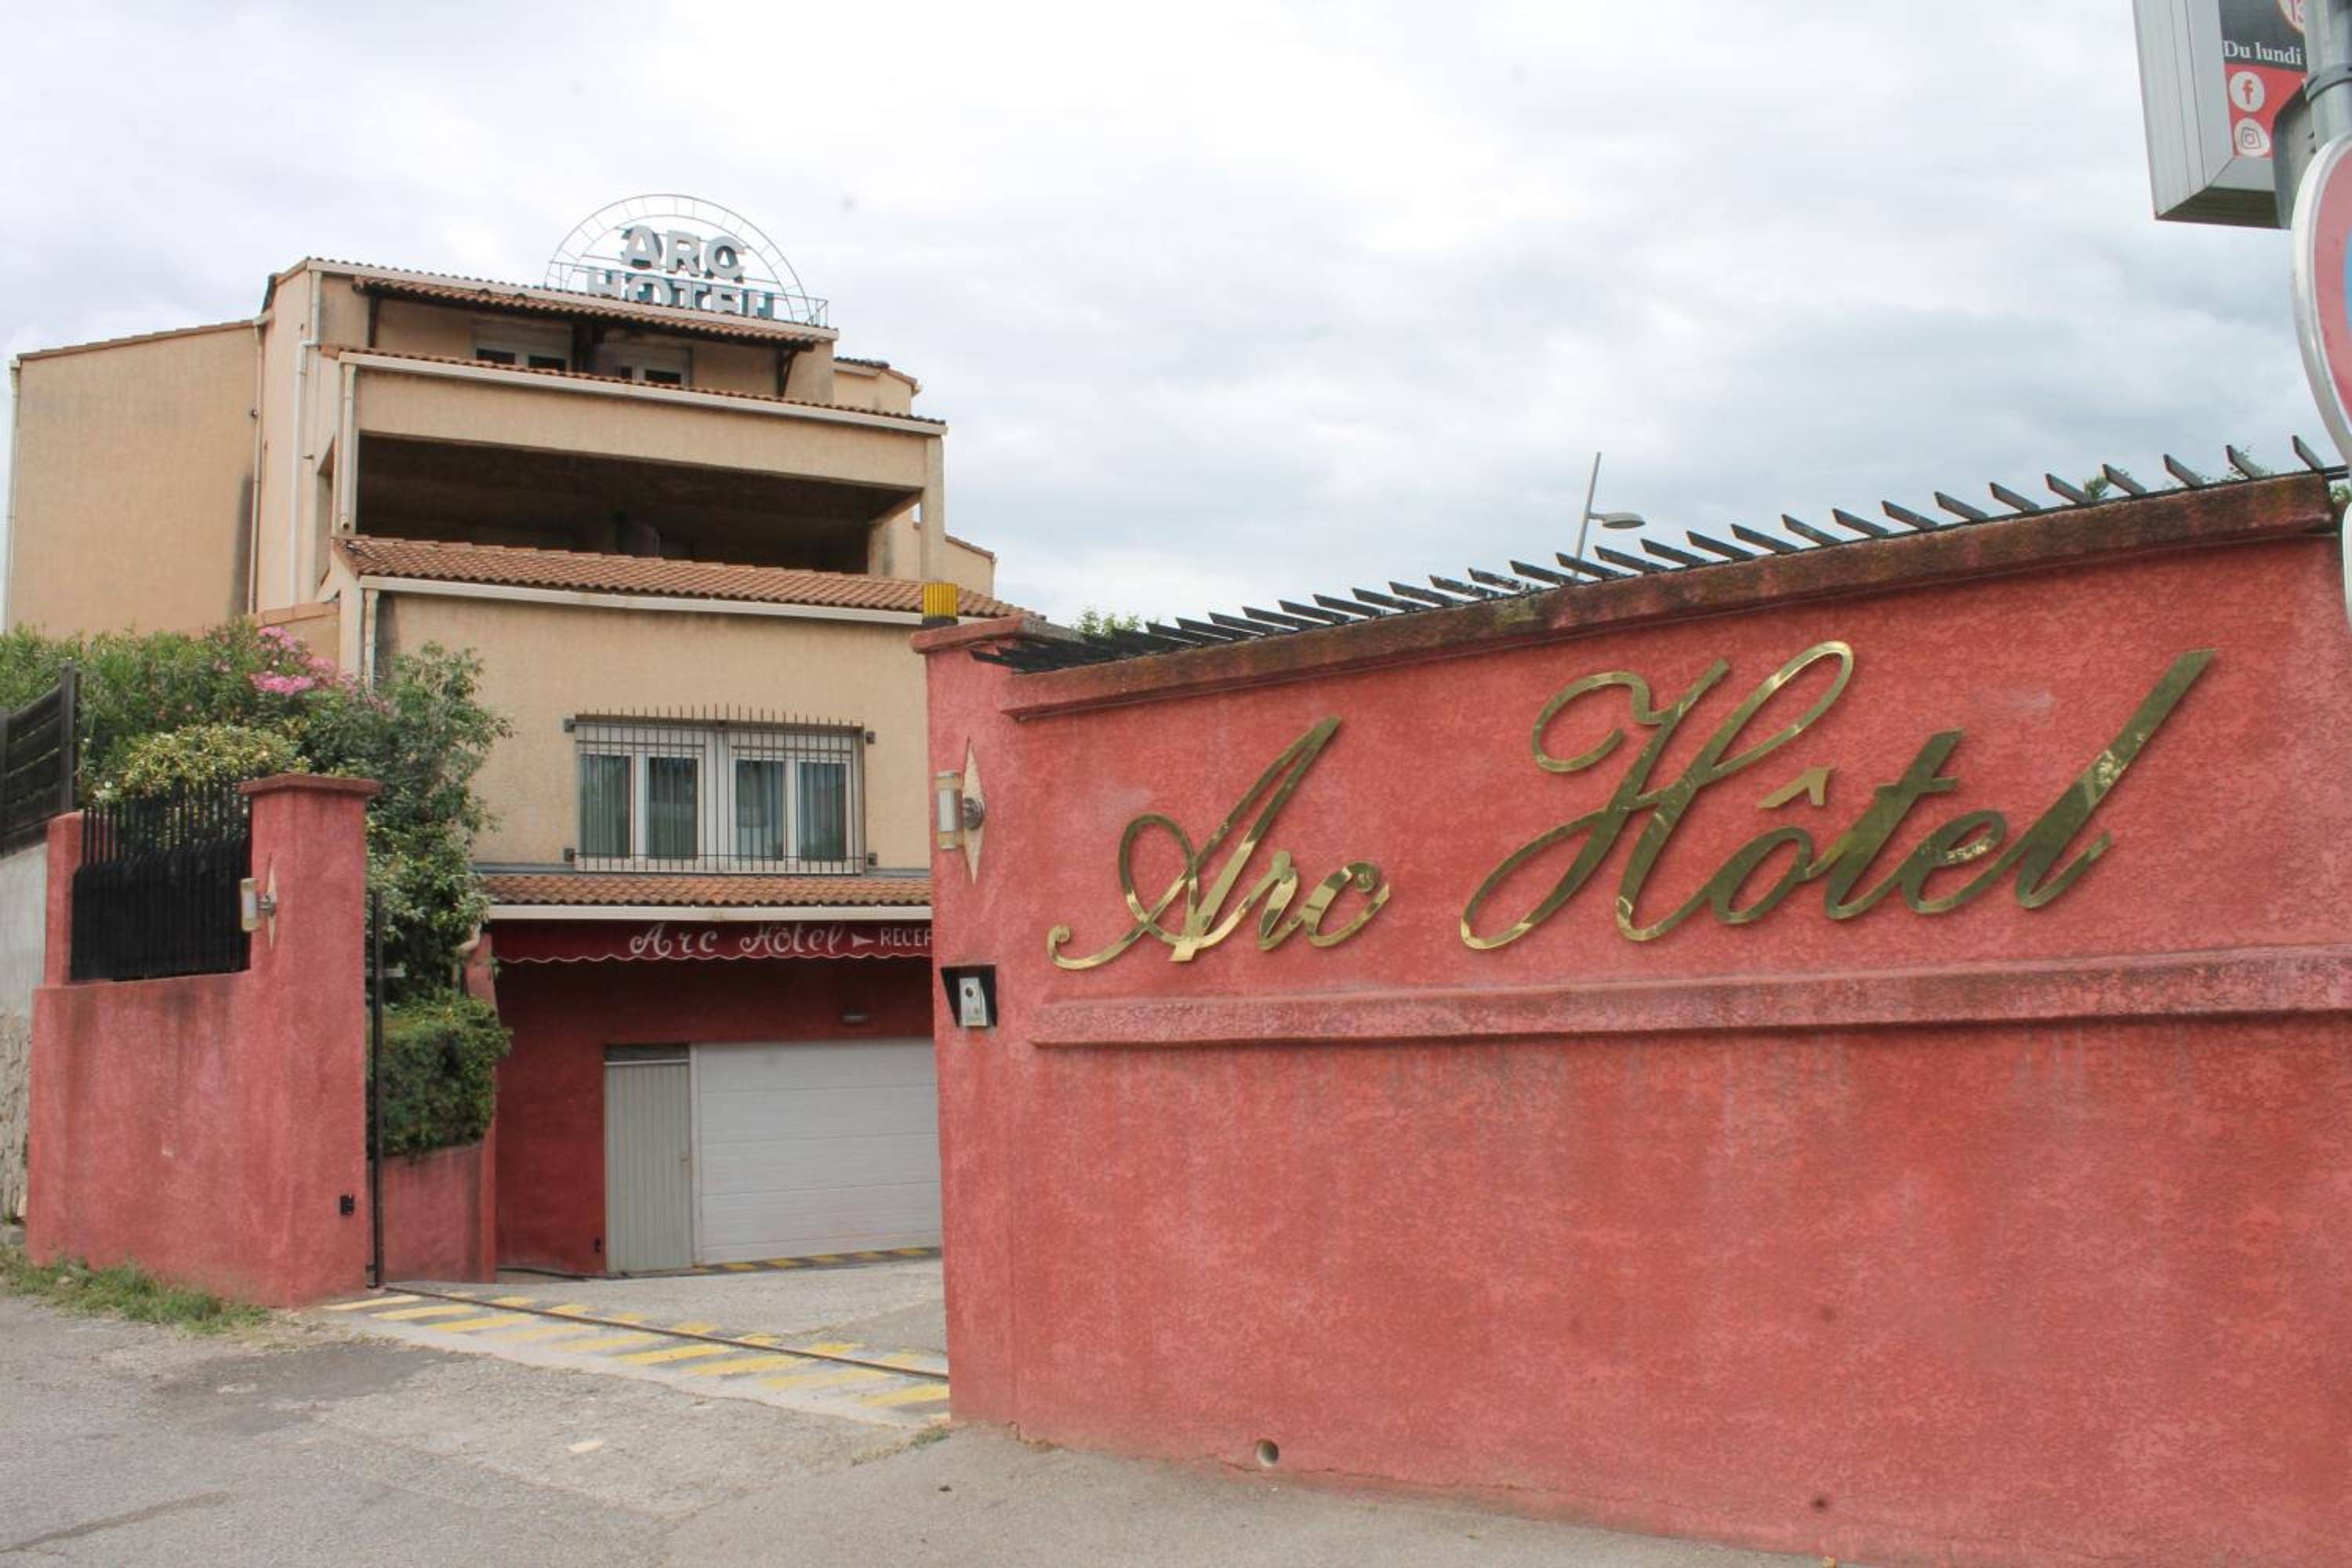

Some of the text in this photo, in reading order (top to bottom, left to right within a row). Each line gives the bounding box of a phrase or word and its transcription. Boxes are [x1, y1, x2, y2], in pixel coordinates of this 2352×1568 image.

[2223, 40, 2303, 65] Du lundi
[622, 224, 746, 283] ARC
[1047, 641, 2216, 970] Arc Hôtel
[630, 922, 718, 956] Arc
